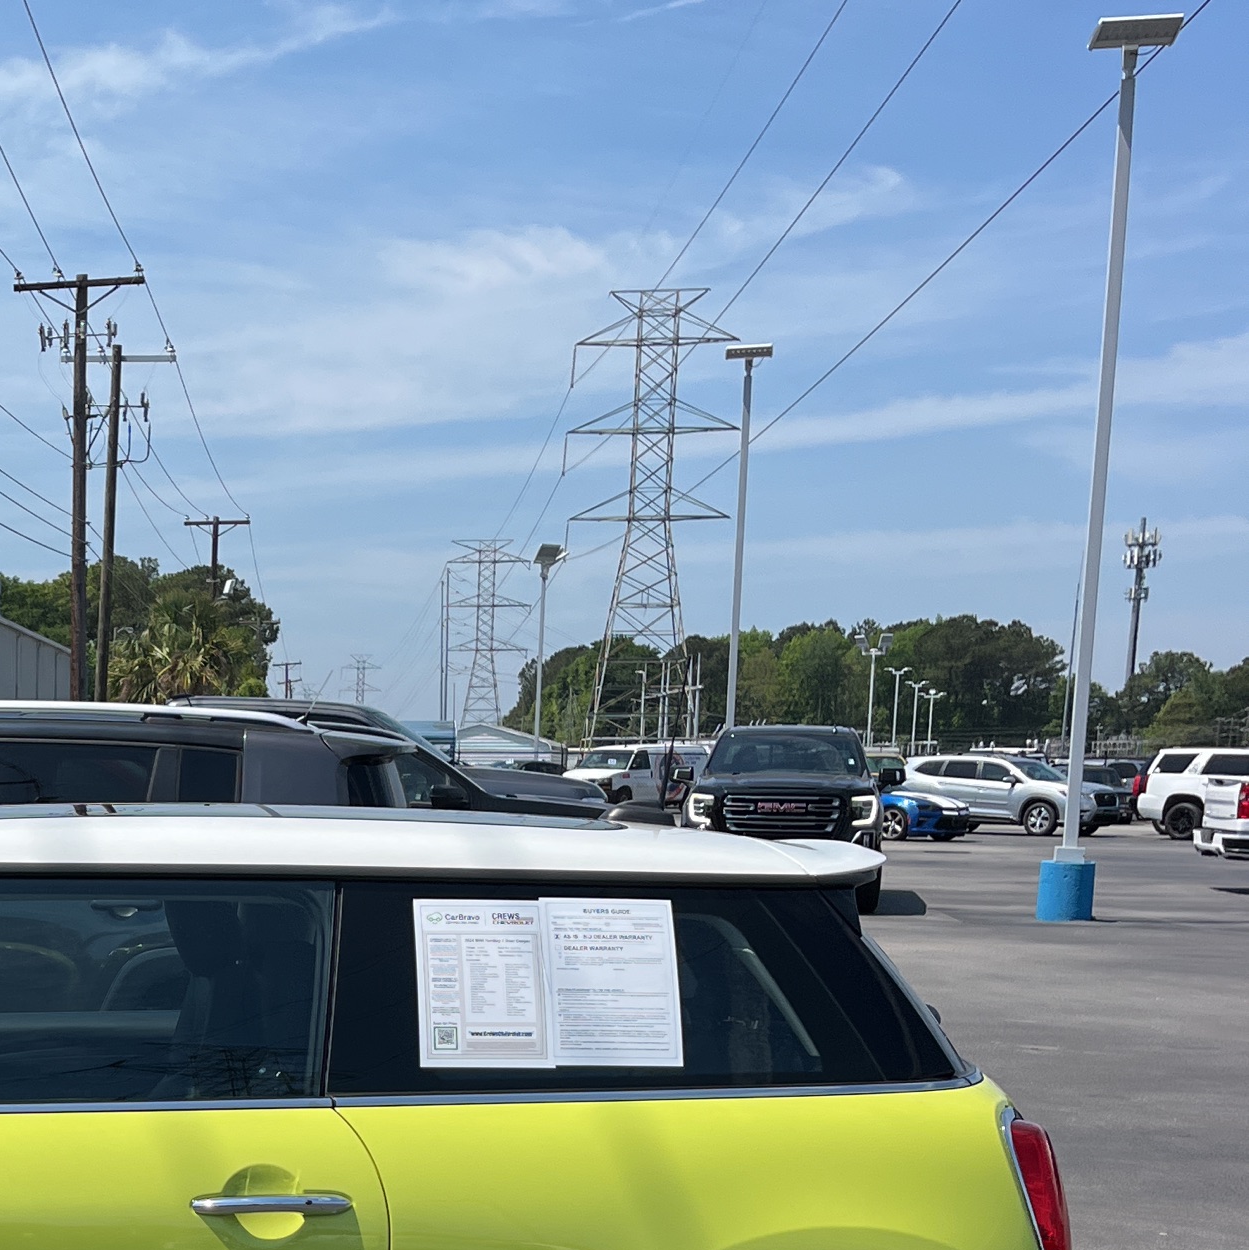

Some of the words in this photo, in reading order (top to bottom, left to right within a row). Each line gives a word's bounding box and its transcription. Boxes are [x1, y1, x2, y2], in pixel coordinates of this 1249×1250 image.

[757, 802, 806, 813] GMC
[444, 913, 480, 921] CarBravo
[492, 912, 520, 920] CREWS
